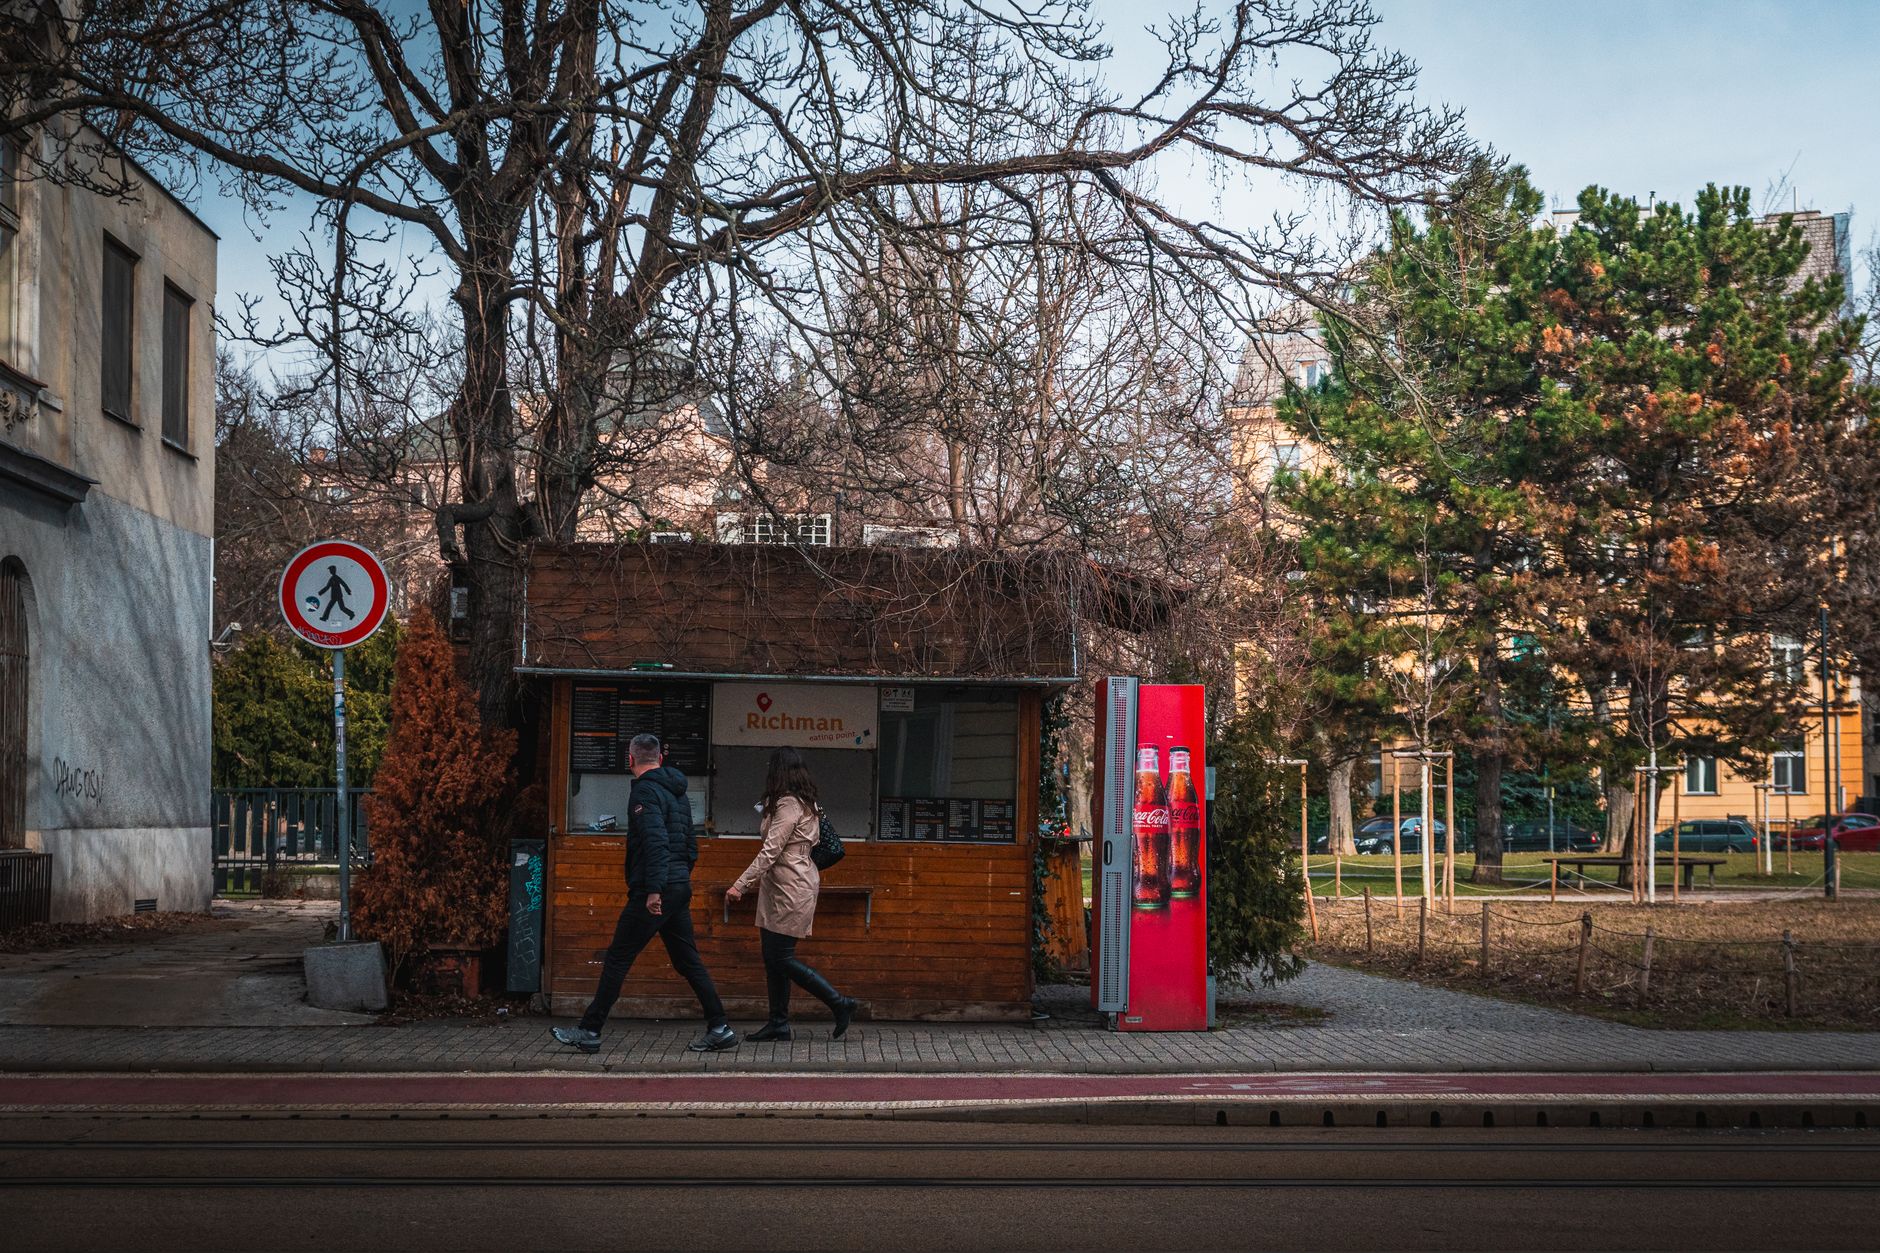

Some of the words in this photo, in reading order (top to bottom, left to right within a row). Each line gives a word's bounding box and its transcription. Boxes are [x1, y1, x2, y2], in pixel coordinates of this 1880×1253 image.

[746, 711, 844, 731] Richman
[809, 731, 834, 742] eating
[835, 731, 857, 740] point
